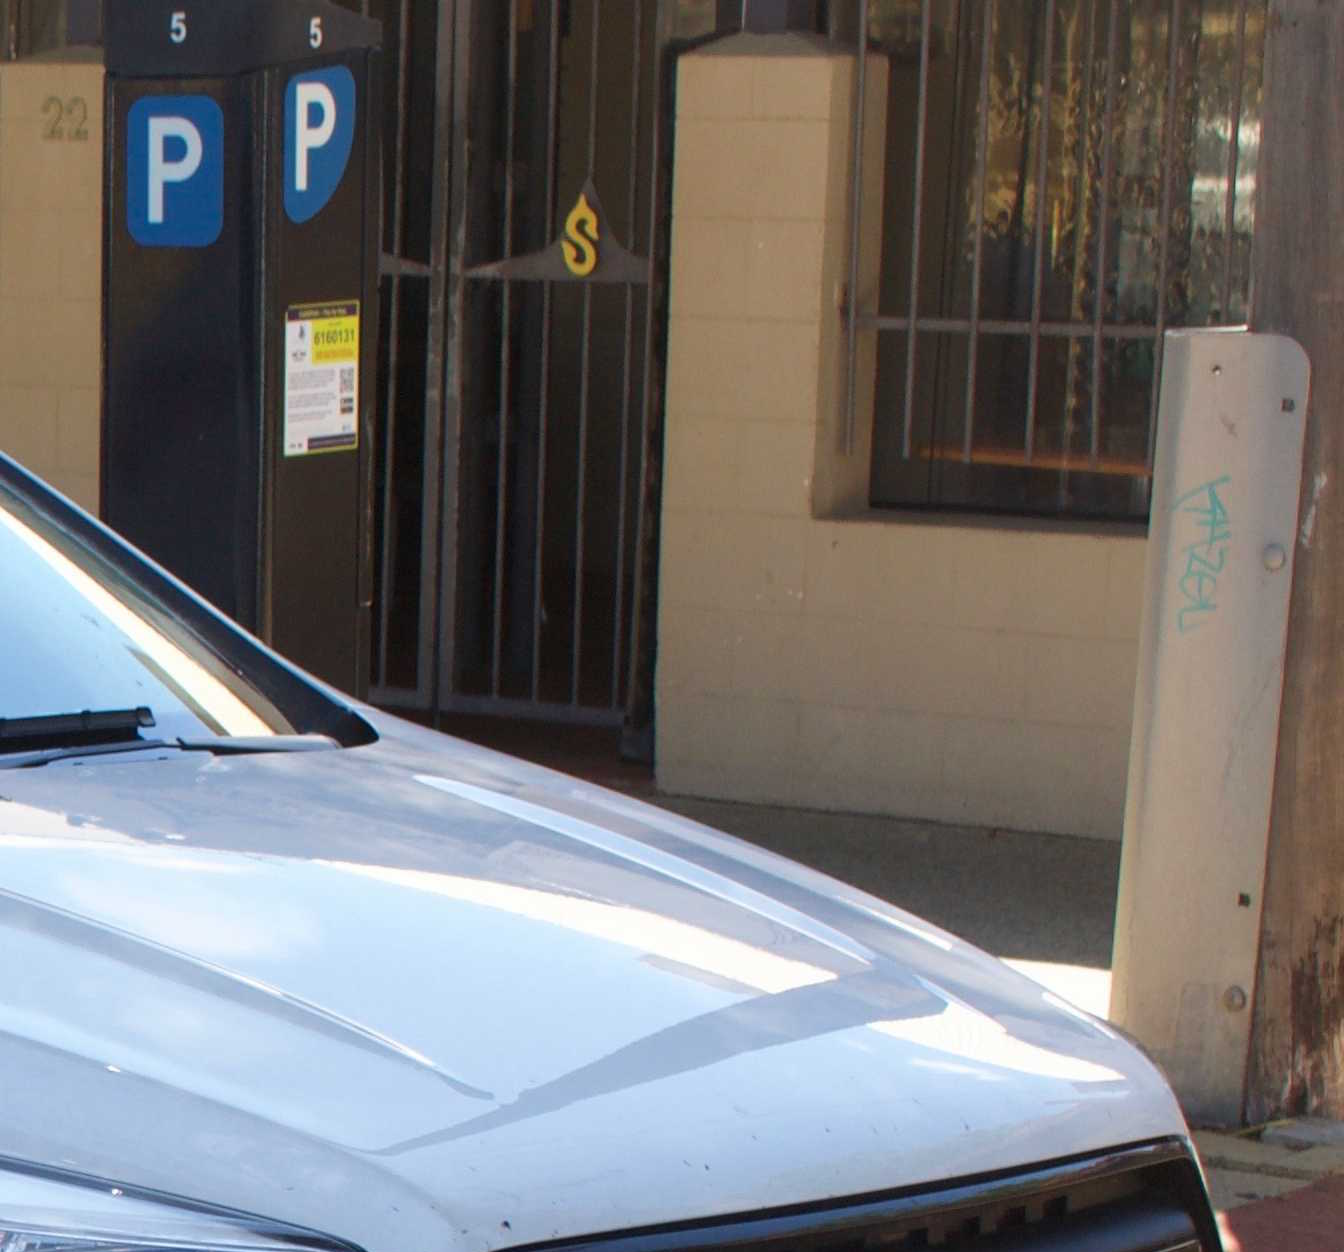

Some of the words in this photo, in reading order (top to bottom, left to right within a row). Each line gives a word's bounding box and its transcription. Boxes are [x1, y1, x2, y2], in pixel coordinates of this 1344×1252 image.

[170, 12, 187, 43] 5
[308, 17, 323, 48] 5
[41, 96, 89, 141] 22
[294, 82, 336, 191] P
[147, 116, 203, 224] P
